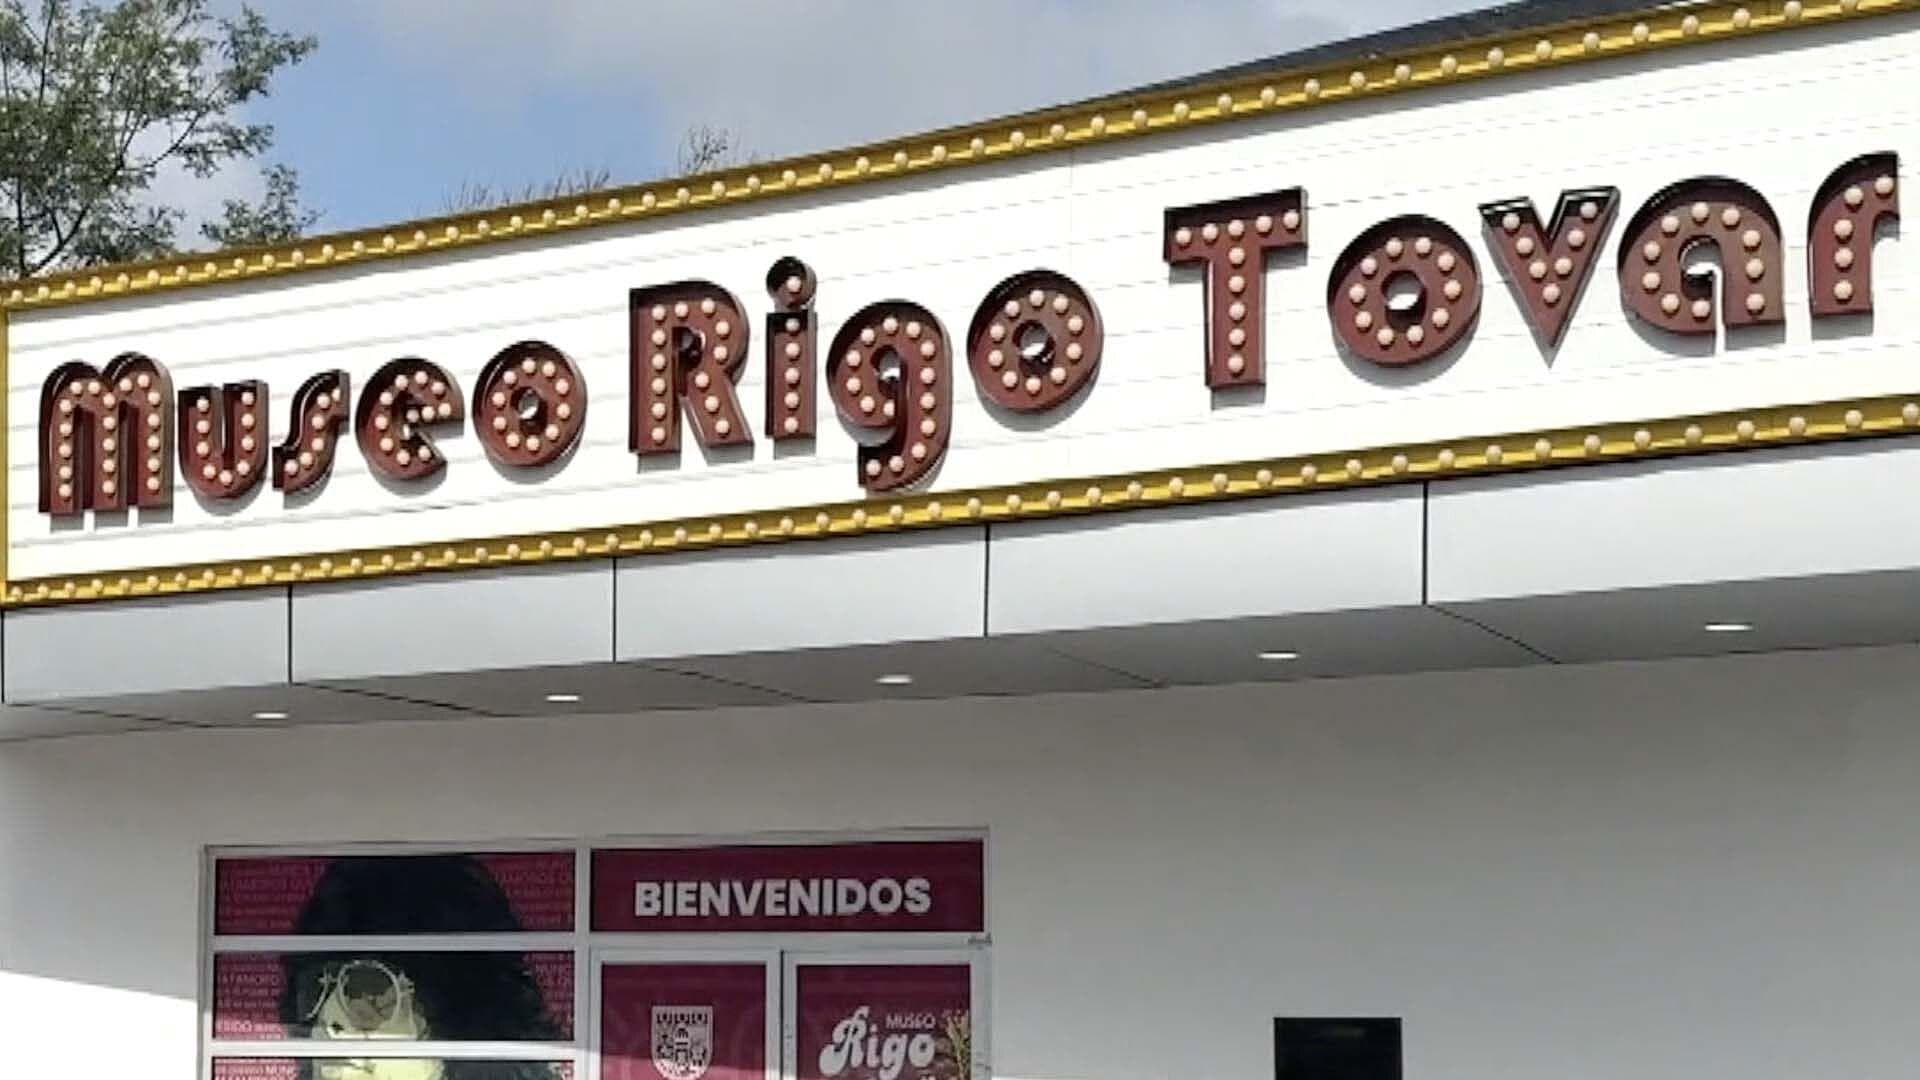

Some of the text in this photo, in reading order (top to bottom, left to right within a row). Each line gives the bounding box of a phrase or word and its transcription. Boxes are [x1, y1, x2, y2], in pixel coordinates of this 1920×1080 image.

[39, 150, 1899, 516] Museo Rigo Tovar
[634, 878, 932, 917] BIENVENIDOS
[819, 1006, 936, 1080] Rigo
